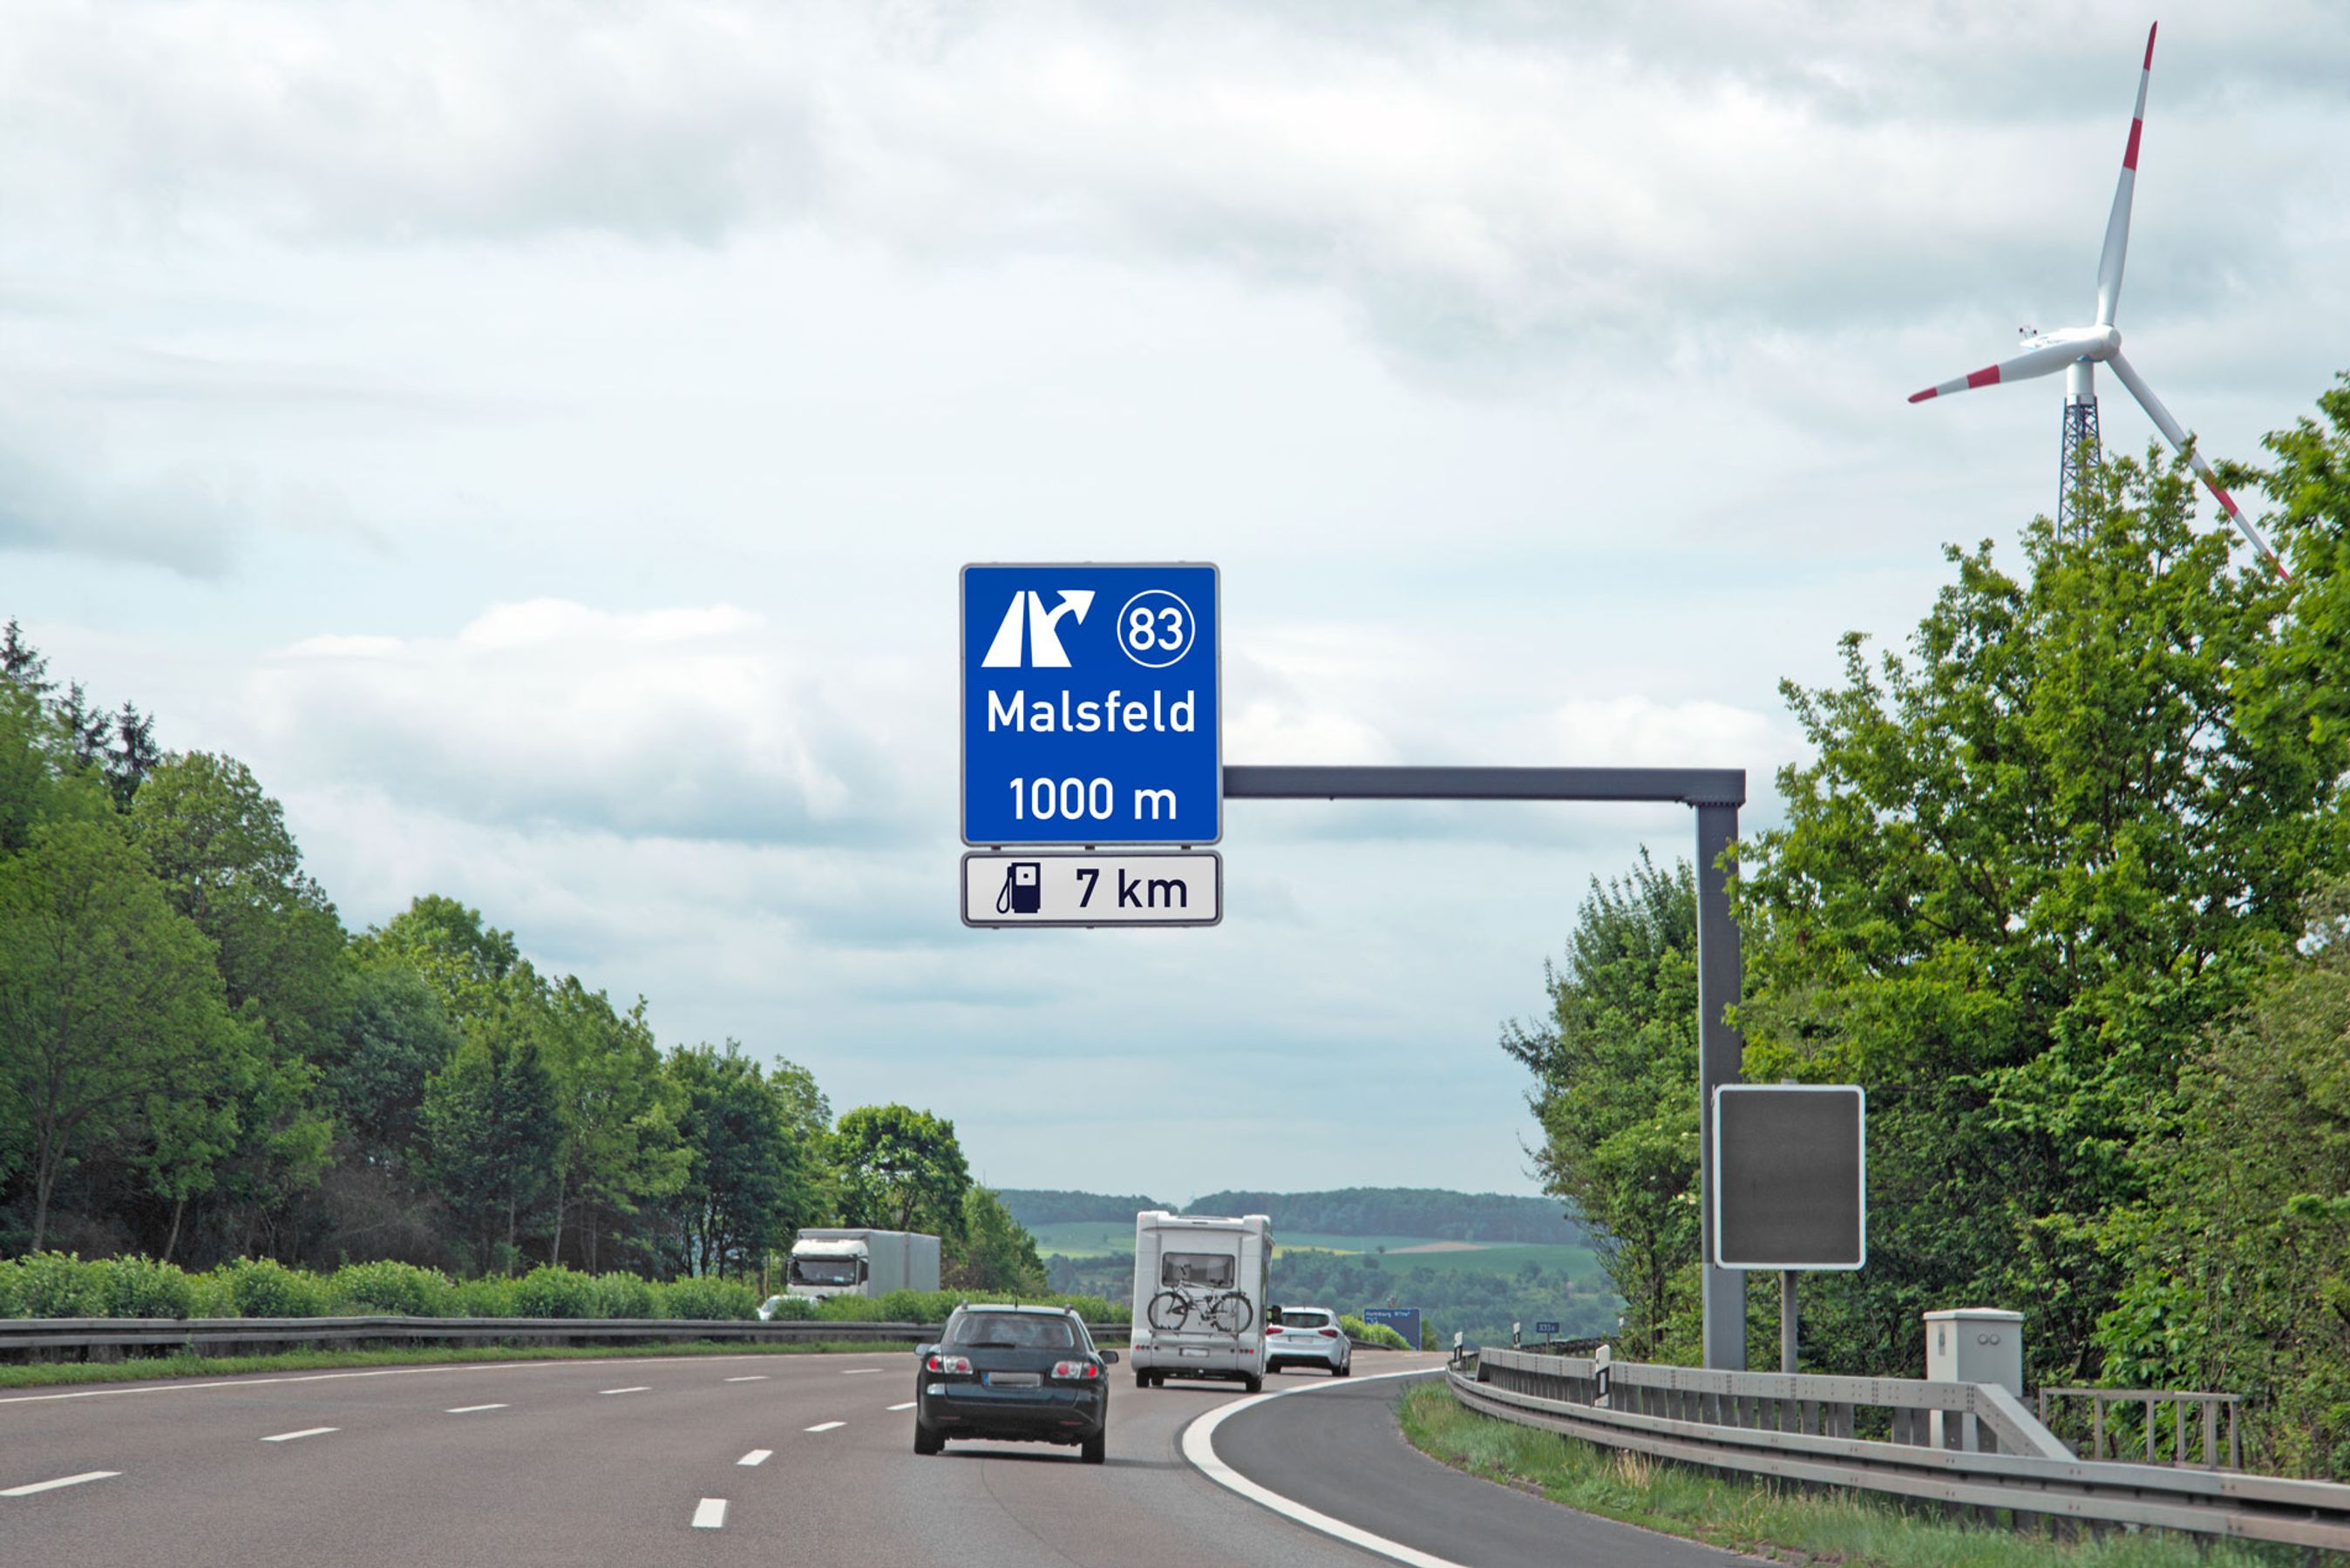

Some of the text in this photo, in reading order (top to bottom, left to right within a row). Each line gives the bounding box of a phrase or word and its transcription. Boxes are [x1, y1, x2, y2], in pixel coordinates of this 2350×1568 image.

[1129, 608, 1184, 650] 83
[988, 690, 1195, 732] Malsfeld
[1009, 777, 1177, 820] 1000 m
[1076, 869, 1187, 908] 7 km
